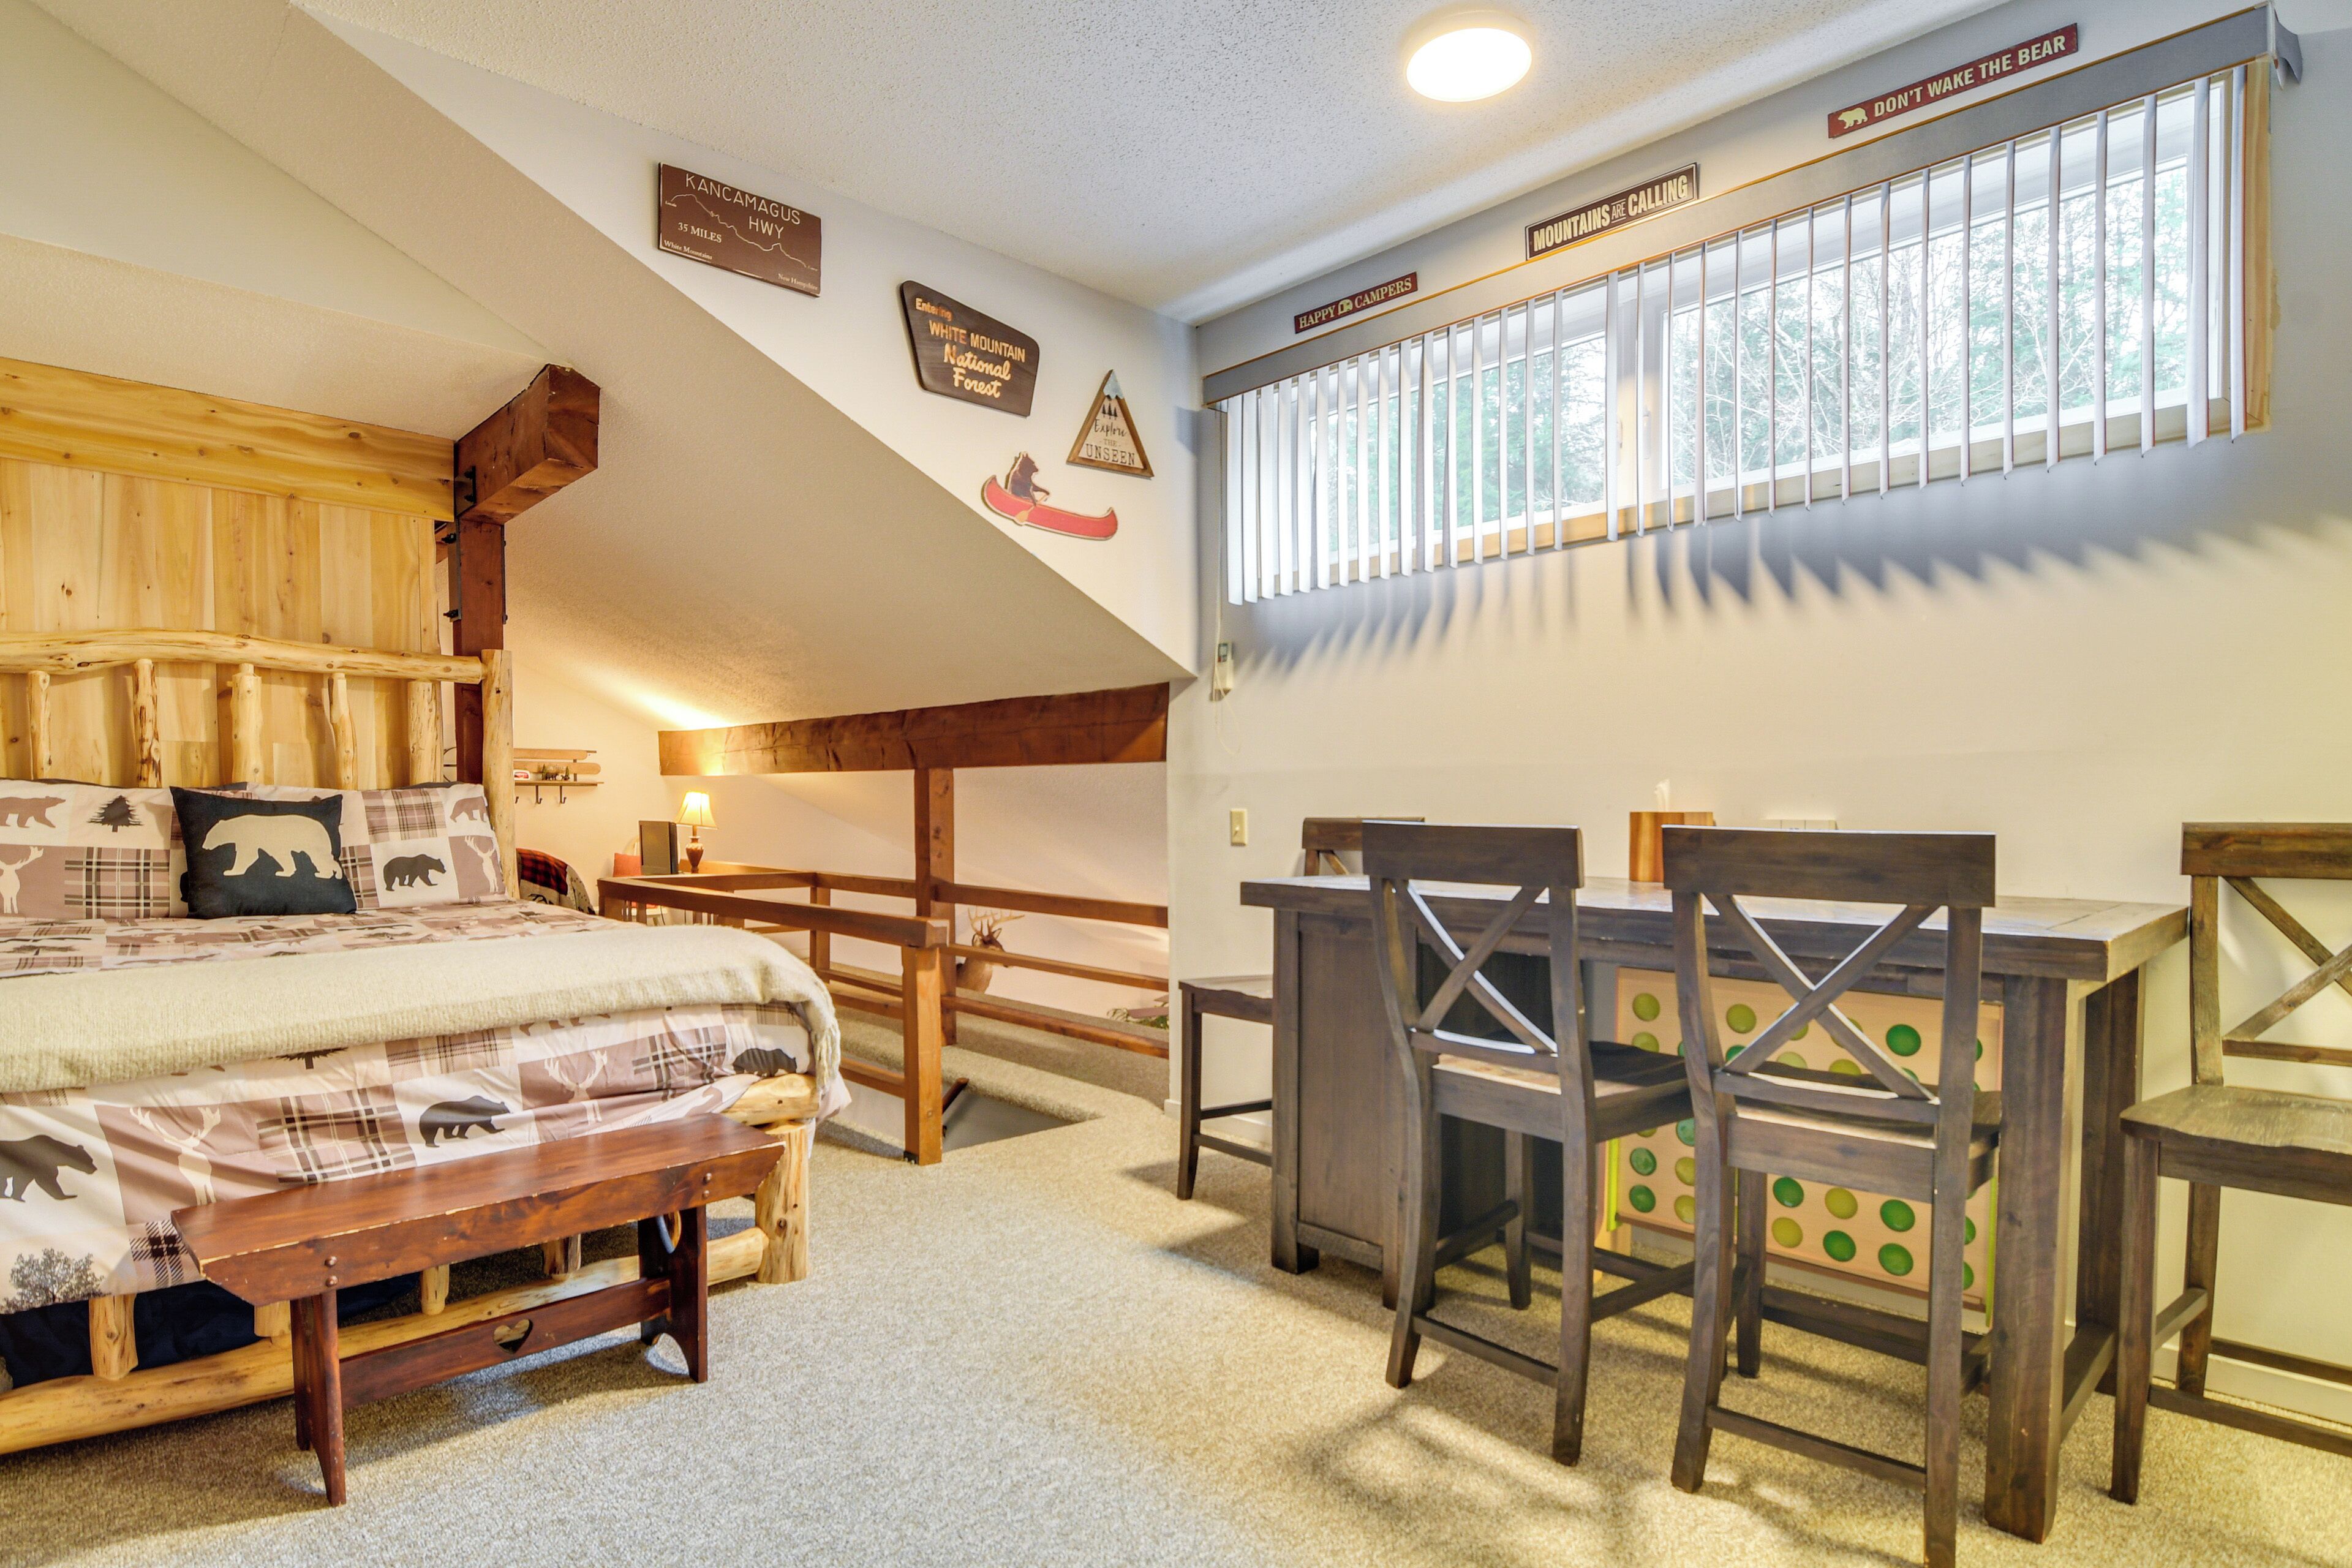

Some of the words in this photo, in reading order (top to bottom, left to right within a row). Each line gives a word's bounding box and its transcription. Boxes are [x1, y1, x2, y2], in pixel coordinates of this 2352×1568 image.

[1874, 86, 1923, 118] DON'T
[1927, 68, 1975, 97] WAKE
[1978, 54, 2013, 79] THE
[2018, 35, 2066, 66] BEAR
[685, 173, 801, 225] KANCAMAGUS
[1533, 204, 1611, 252] MOUNTAINS
[1611, 202, 1626, 220] ARE
[1627, 175, 1688, 216] CALLING
[678, 222, 688, 232] 35
[690, 225, 722, 243] MILES
[749, 216, 784, 239] HWY
[664, 239, 682, 251] White
[683, 246, 712, 260] Mountains
[915, 298, 953, 322] Entering
[1299, 305, 1335, 329] HAPPY
[1354, 277, 1412, 309] CAMPERS
[929, 320, 967, 345] WHITE
[970, 332, 1025, 363] MOUNTAIN
[943, 342, 1011, 381] National
[952, 367, 1002, 398] Forest
[1094, 418, 1128, 437] Explore
[1085, 443, 1135, 466] UNSEEN
